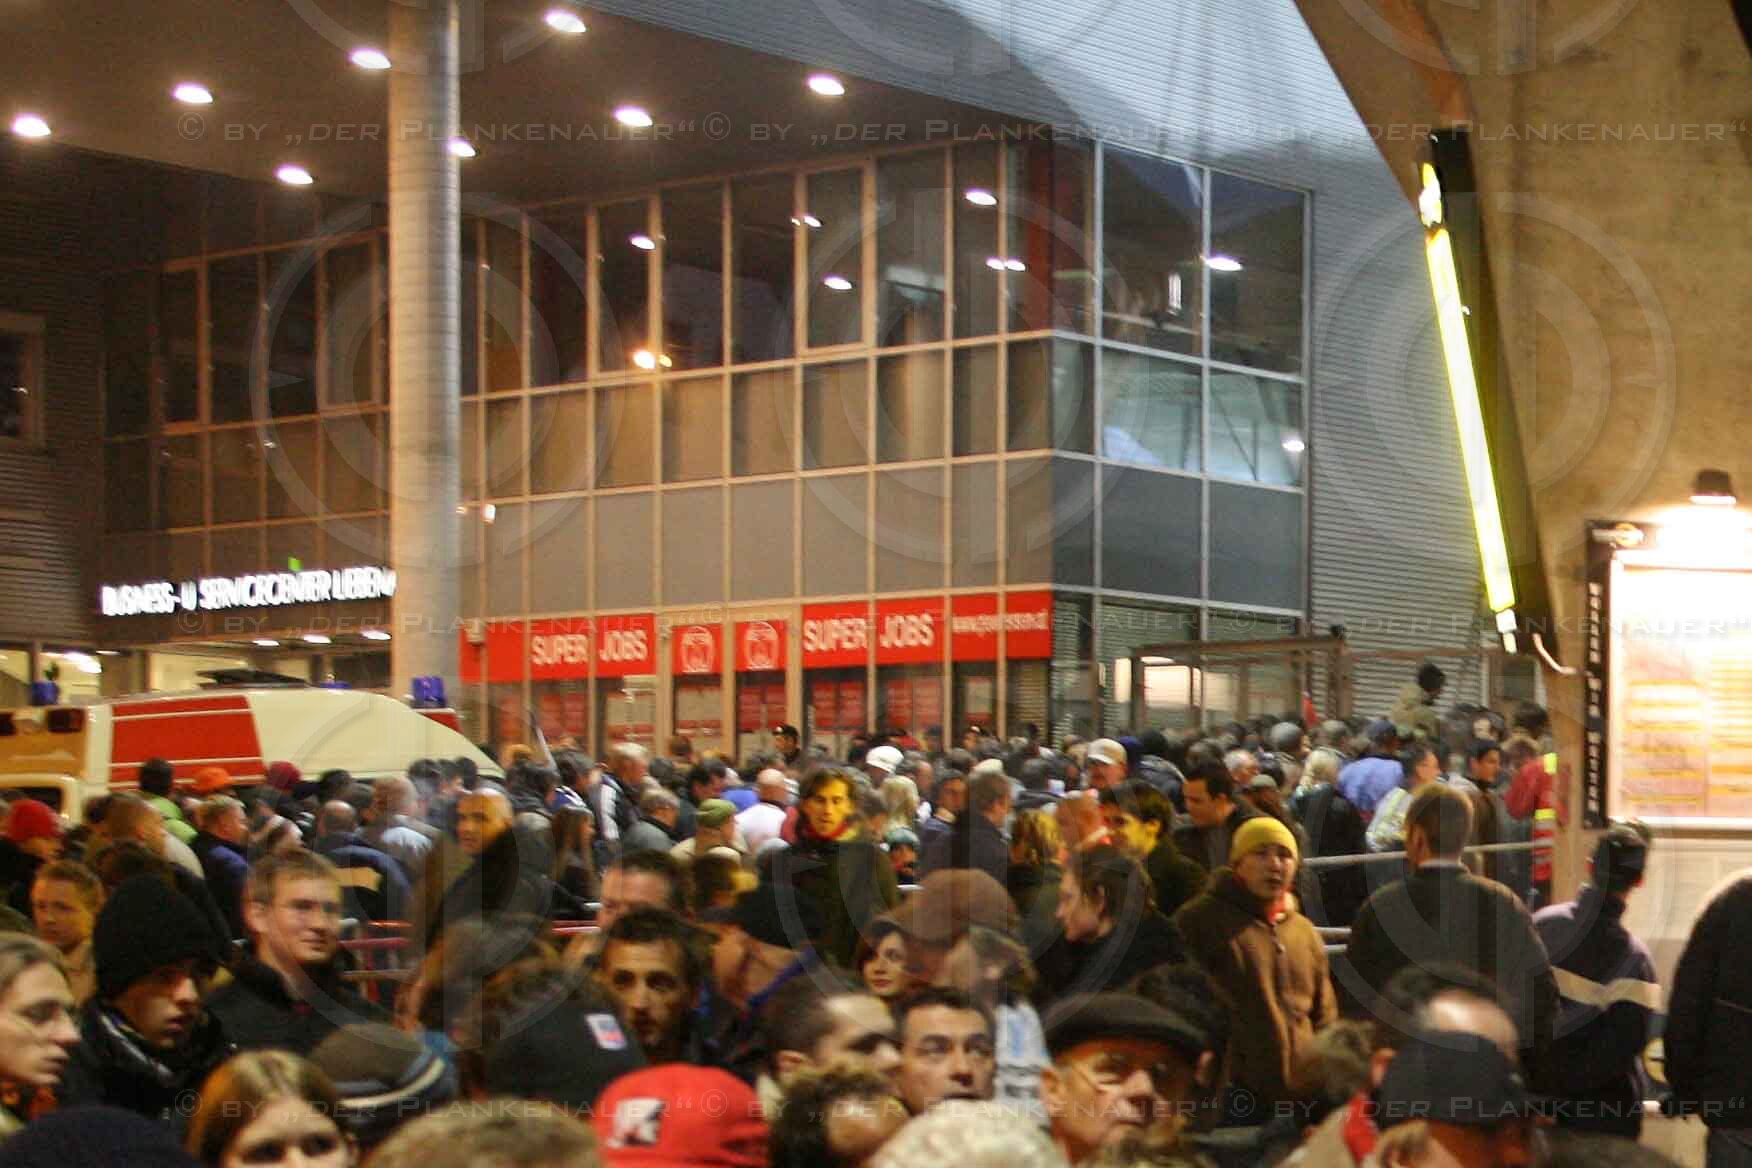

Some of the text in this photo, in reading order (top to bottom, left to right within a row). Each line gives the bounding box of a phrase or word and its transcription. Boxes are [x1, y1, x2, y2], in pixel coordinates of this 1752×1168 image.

[531, 628, 648, 665] SUPER JOBS
[803, 616, 869, 652] SUPER
[879, 613, 935, 649] JOBS
